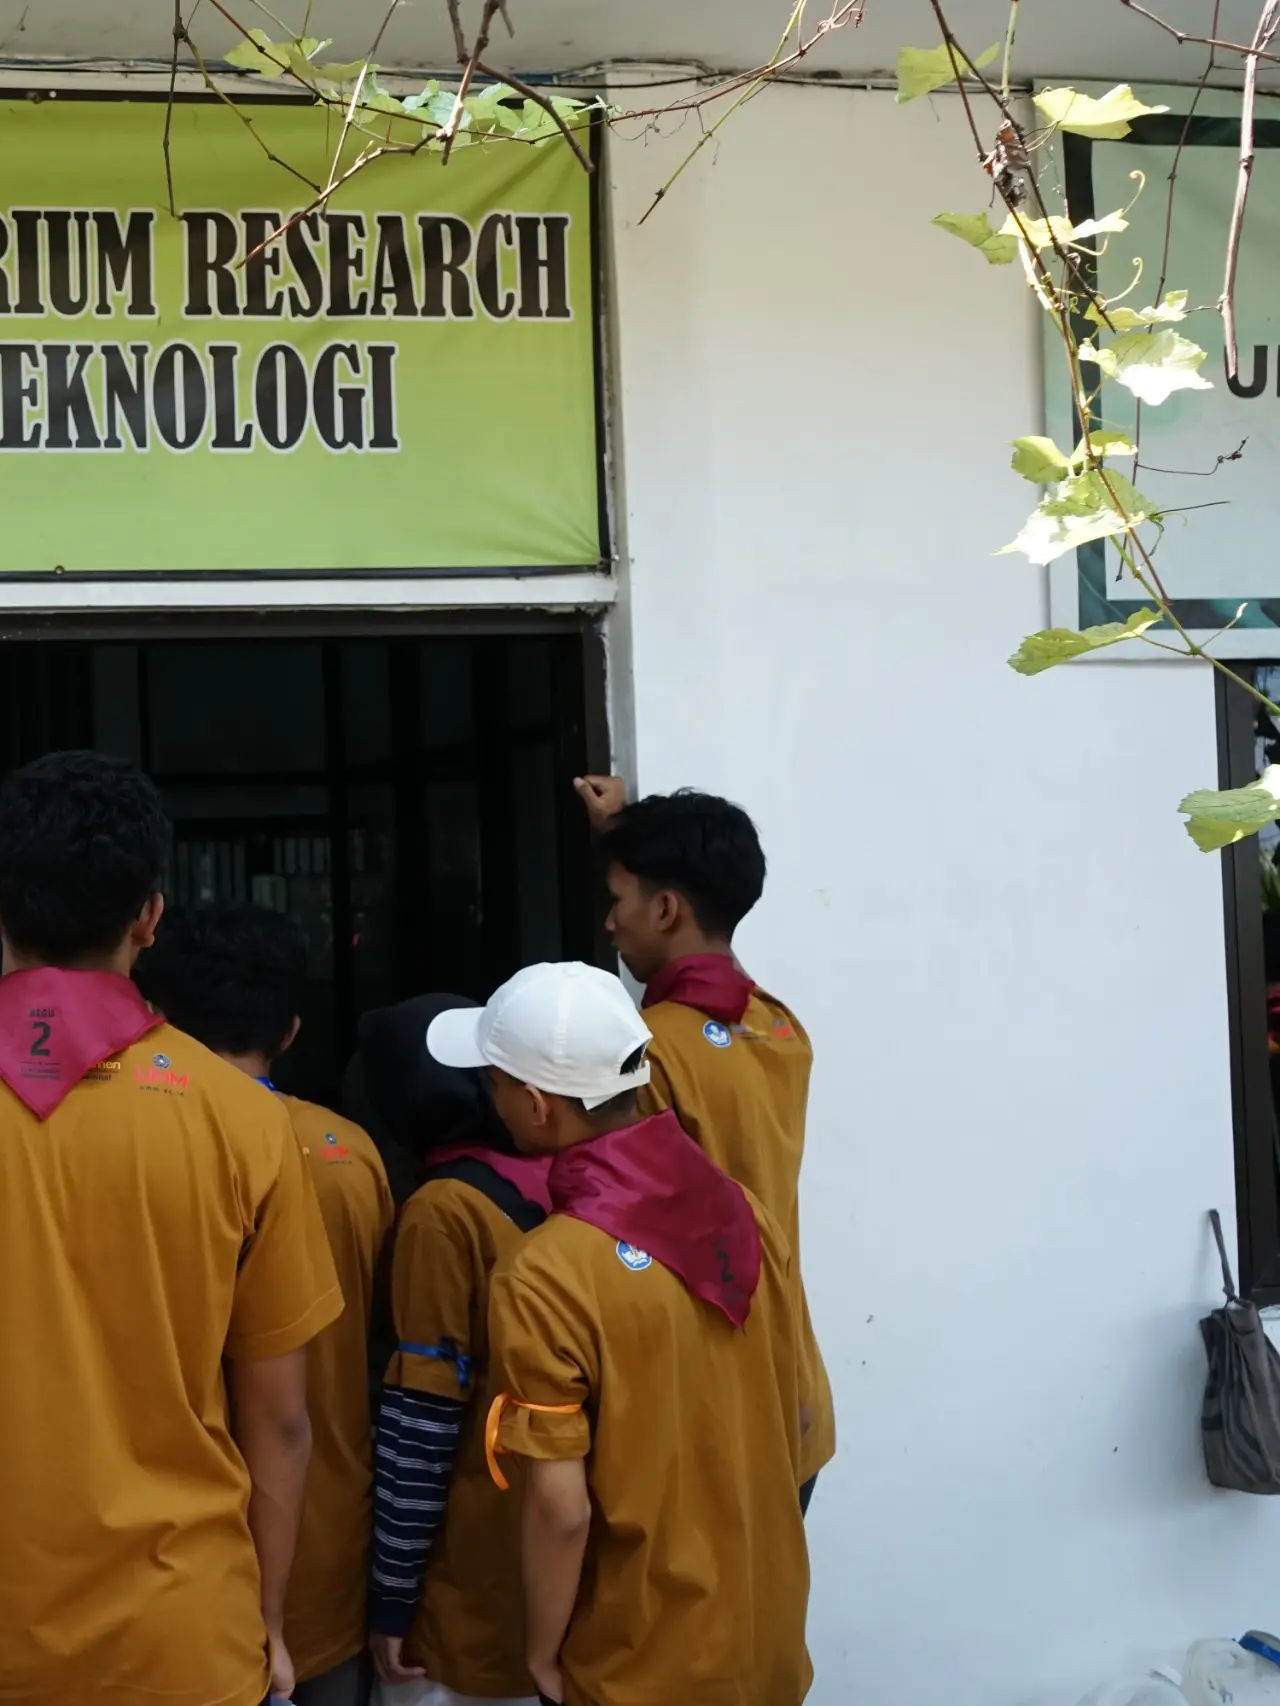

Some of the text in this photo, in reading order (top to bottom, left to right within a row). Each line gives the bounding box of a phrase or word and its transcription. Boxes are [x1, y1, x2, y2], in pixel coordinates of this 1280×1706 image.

[176, 210, 571, 319] RESEARCH
[30, 1021, 51, 1057] 2
[133, 1066, 188, 1088] UMM
